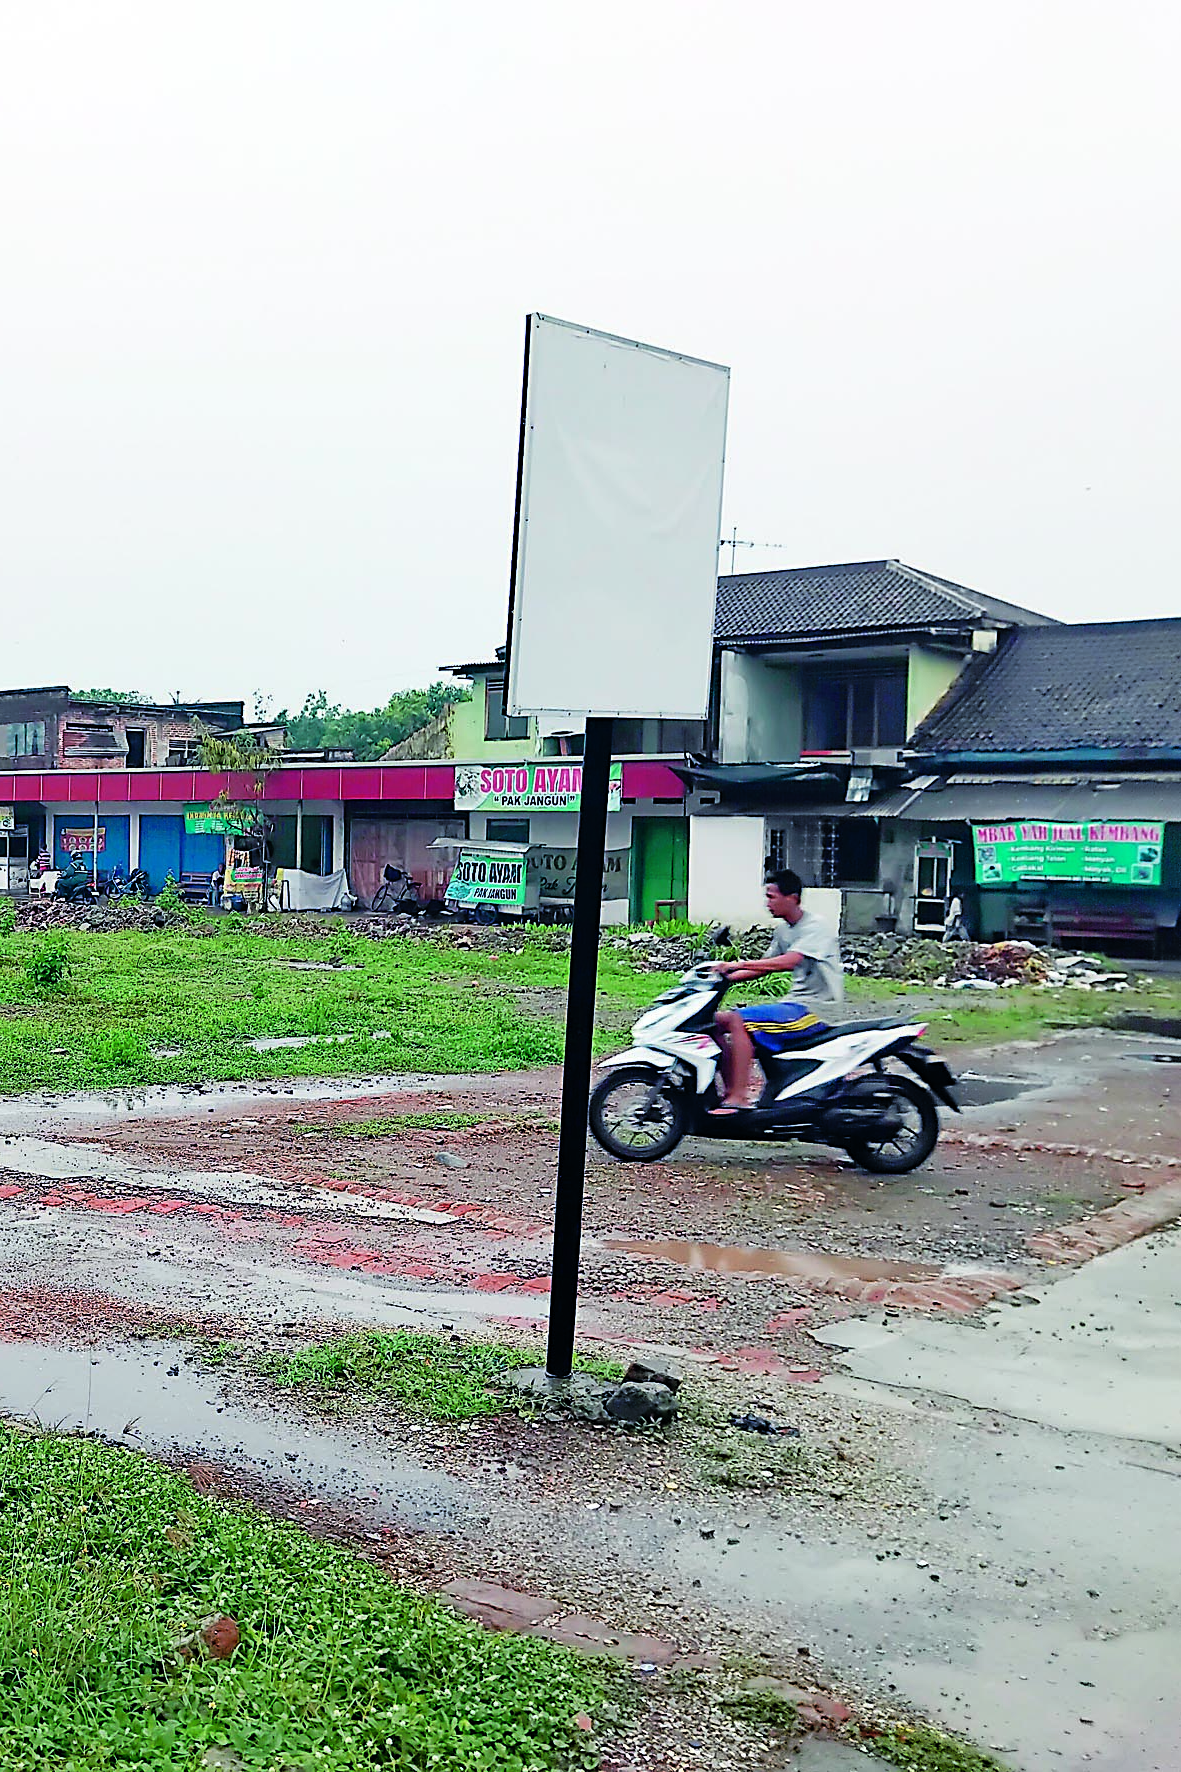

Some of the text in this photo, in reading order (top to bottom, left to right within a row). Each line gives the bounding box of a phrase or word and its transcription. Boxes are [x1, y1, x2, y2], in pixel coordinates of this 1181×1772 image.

[480, 769, 527, 793] SOTO
[977, 826, 1016, 842] MBAK
[1052, 825, 1084, 841] JUAL
[1087, 825, 1160, 841] KEMBANG
[456, 861, 522, 883] SOTO AYAM
[474, 887, 517, 900] PAK JANGUN
